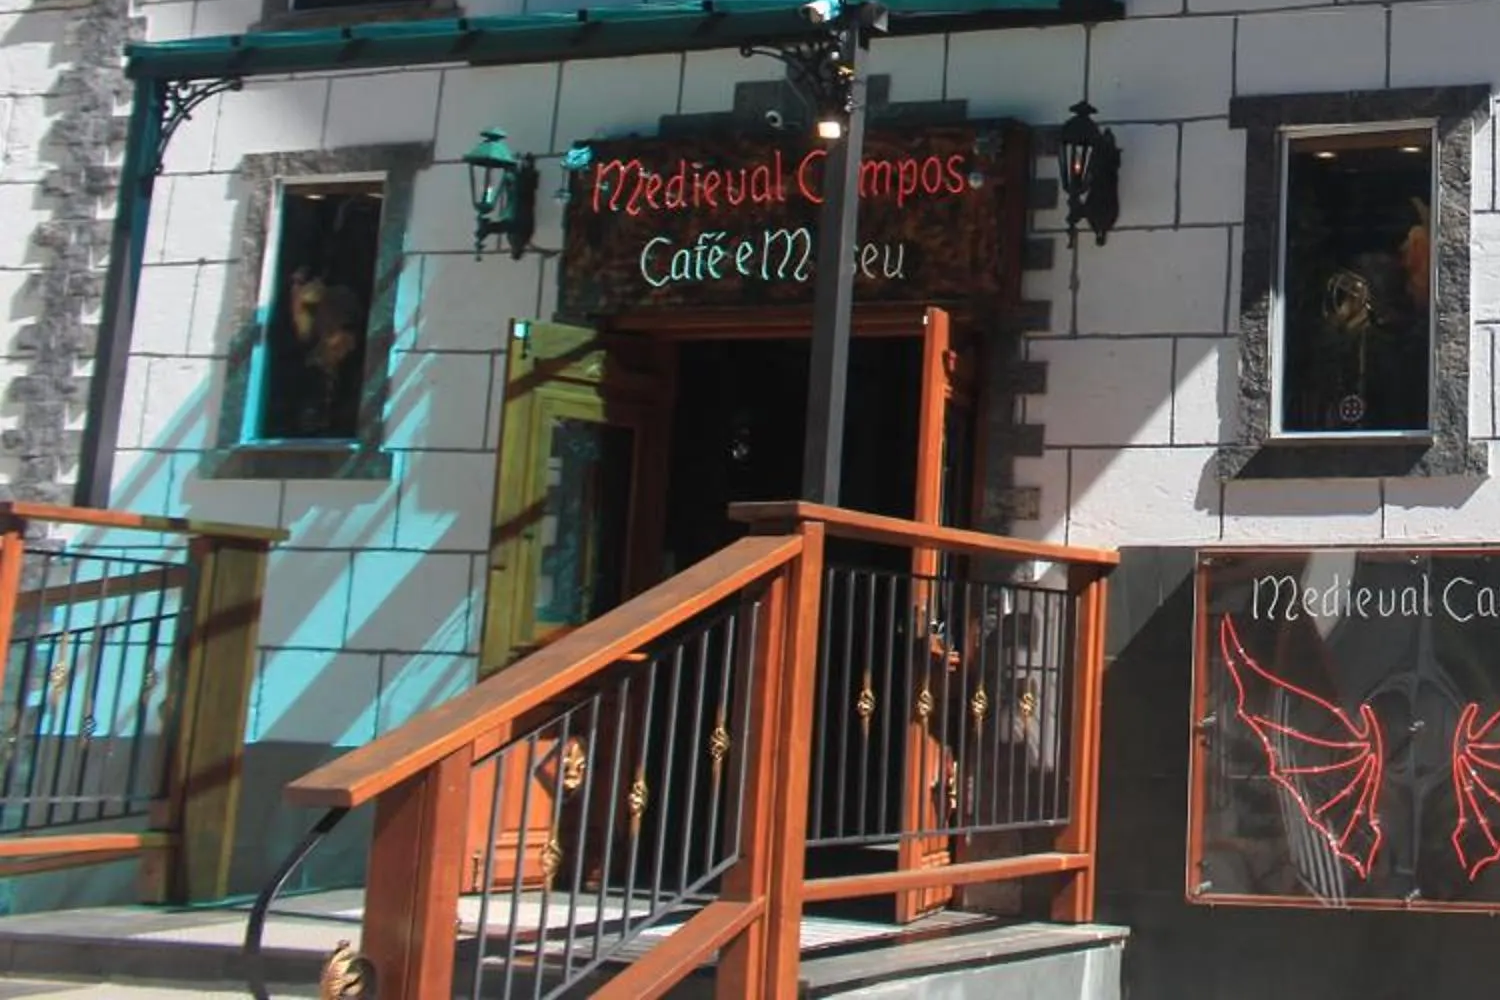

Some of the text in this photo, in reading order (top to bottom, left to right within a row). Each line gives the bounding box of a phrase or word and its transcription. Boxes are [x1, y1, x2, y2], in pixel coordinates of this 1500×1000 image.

[592, 149, 965, 215] Medieval Cmpos
[640, 227, 905, 287] Café e Meu
[1252, 573, 1433, 621] Medieval
